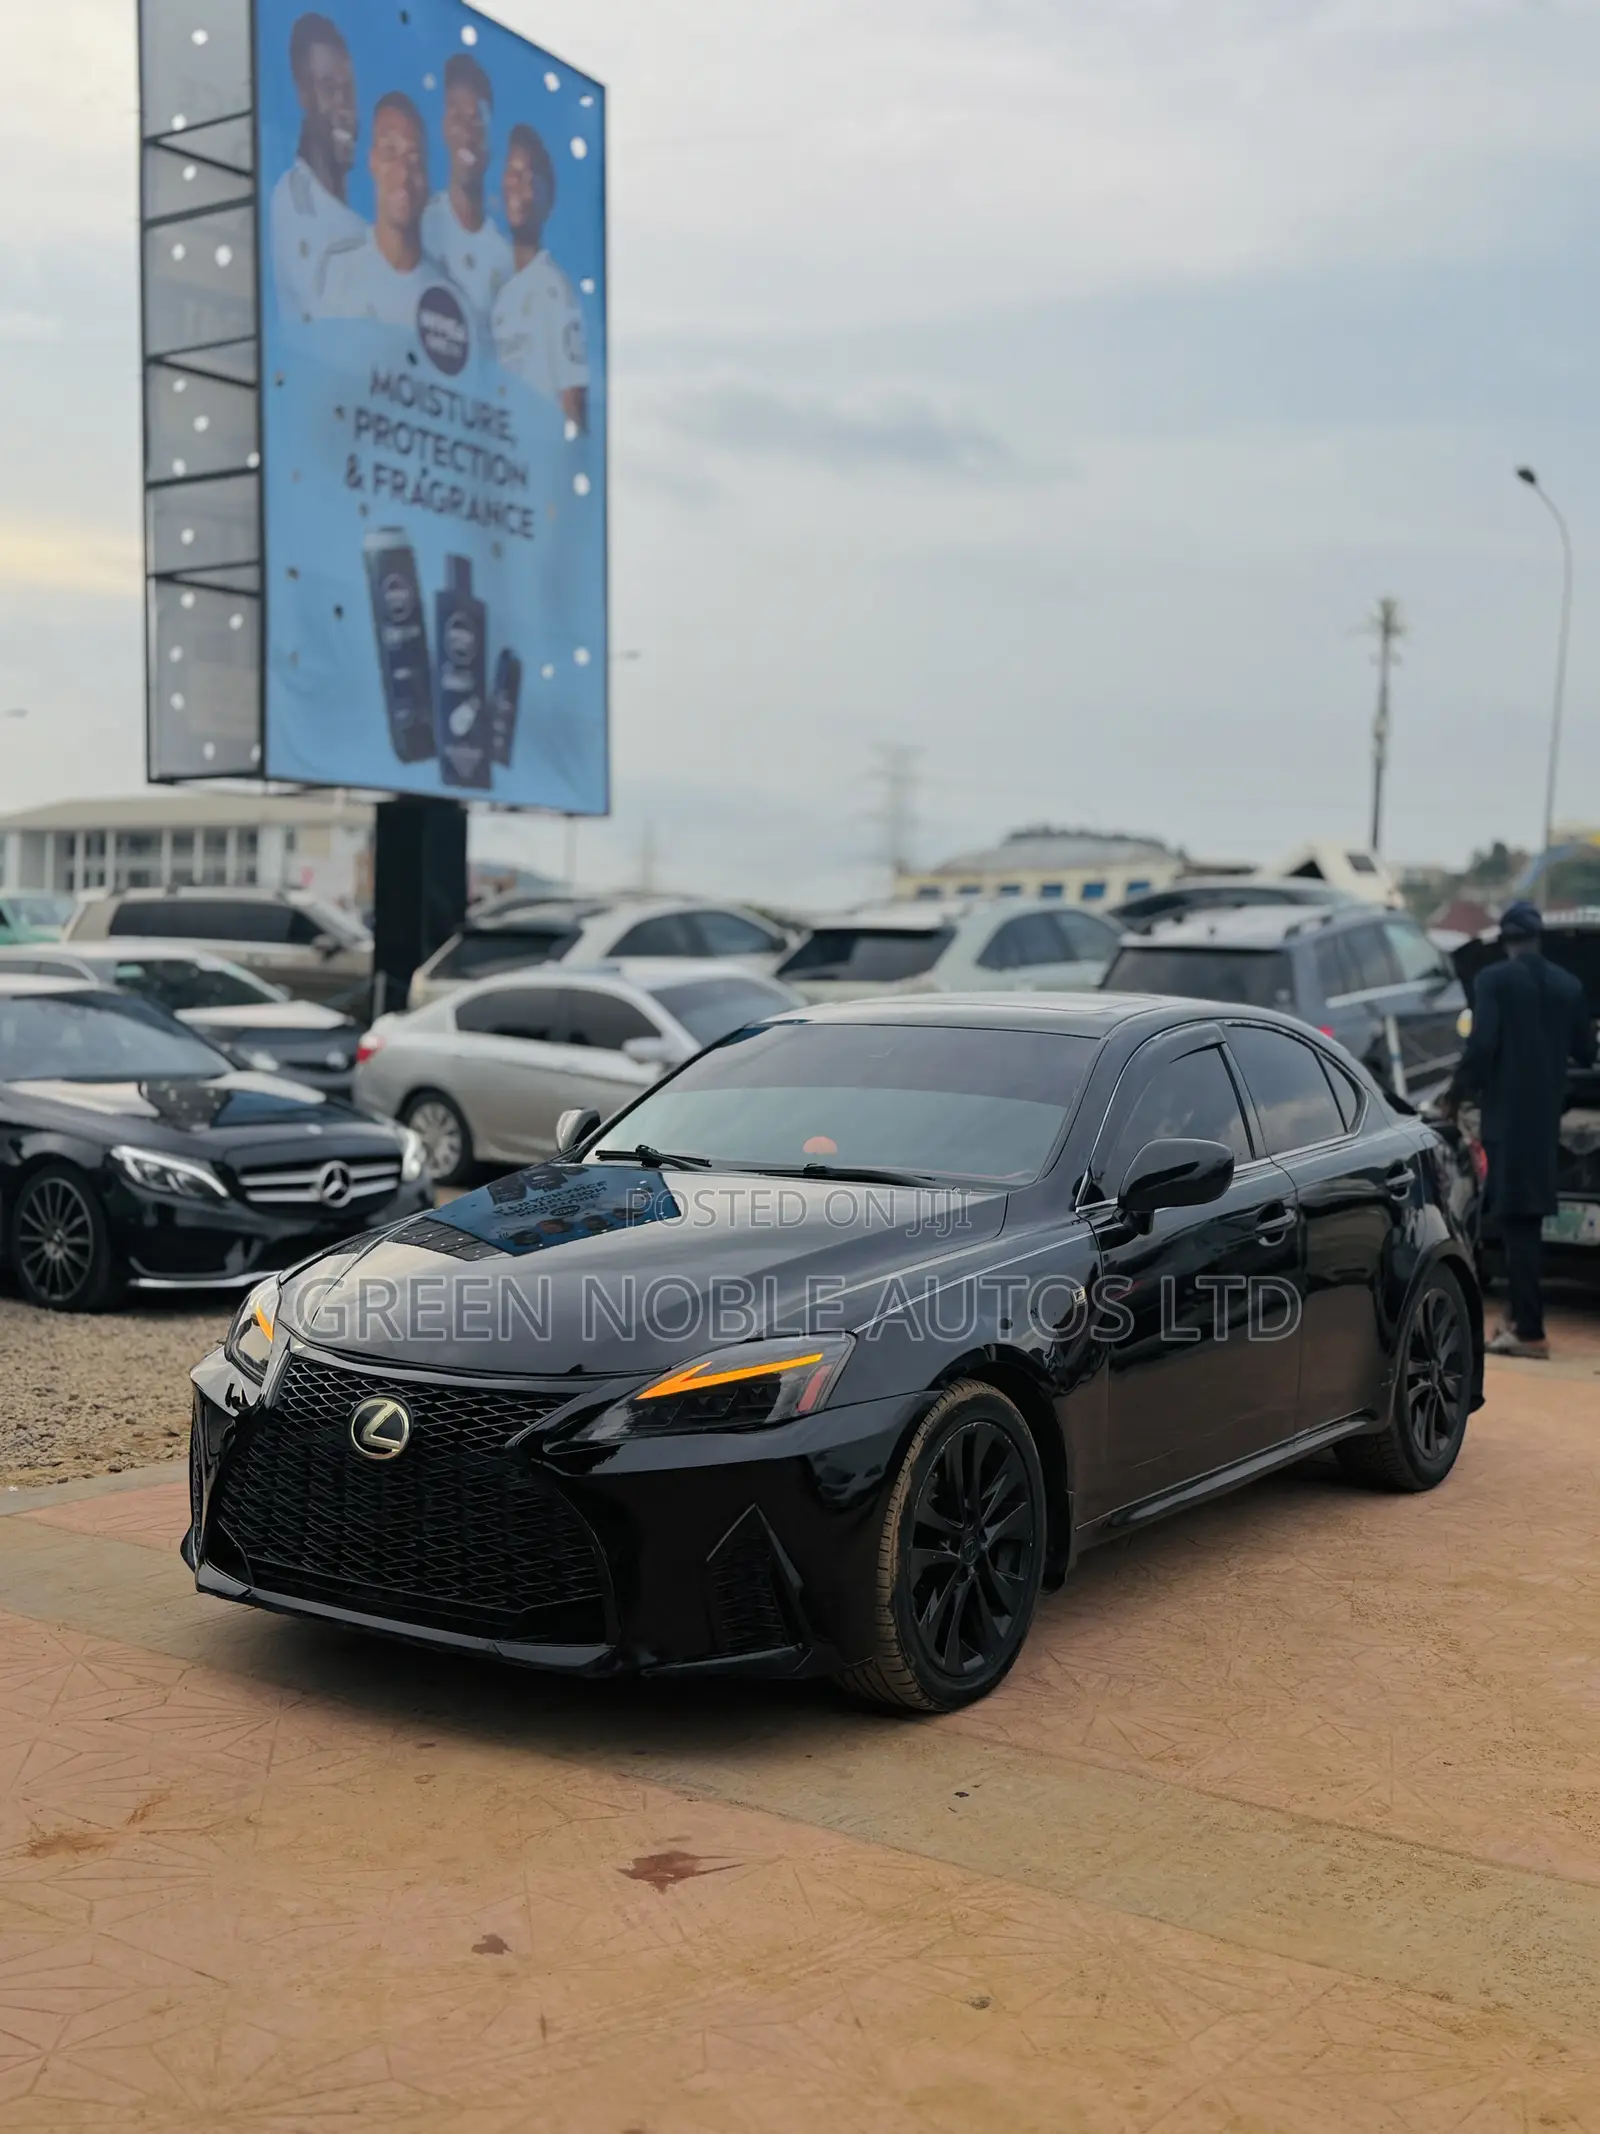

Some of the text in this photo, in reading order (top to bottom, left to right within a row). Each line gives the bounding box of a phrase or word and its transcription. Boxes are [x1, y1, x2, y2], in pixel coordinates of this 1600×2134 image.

[354, 406, 528, 490] PROTECTION
[370, 365, 515, 447] MOISTURE
[346, 453, 535, 540] & FRAGRANCE
